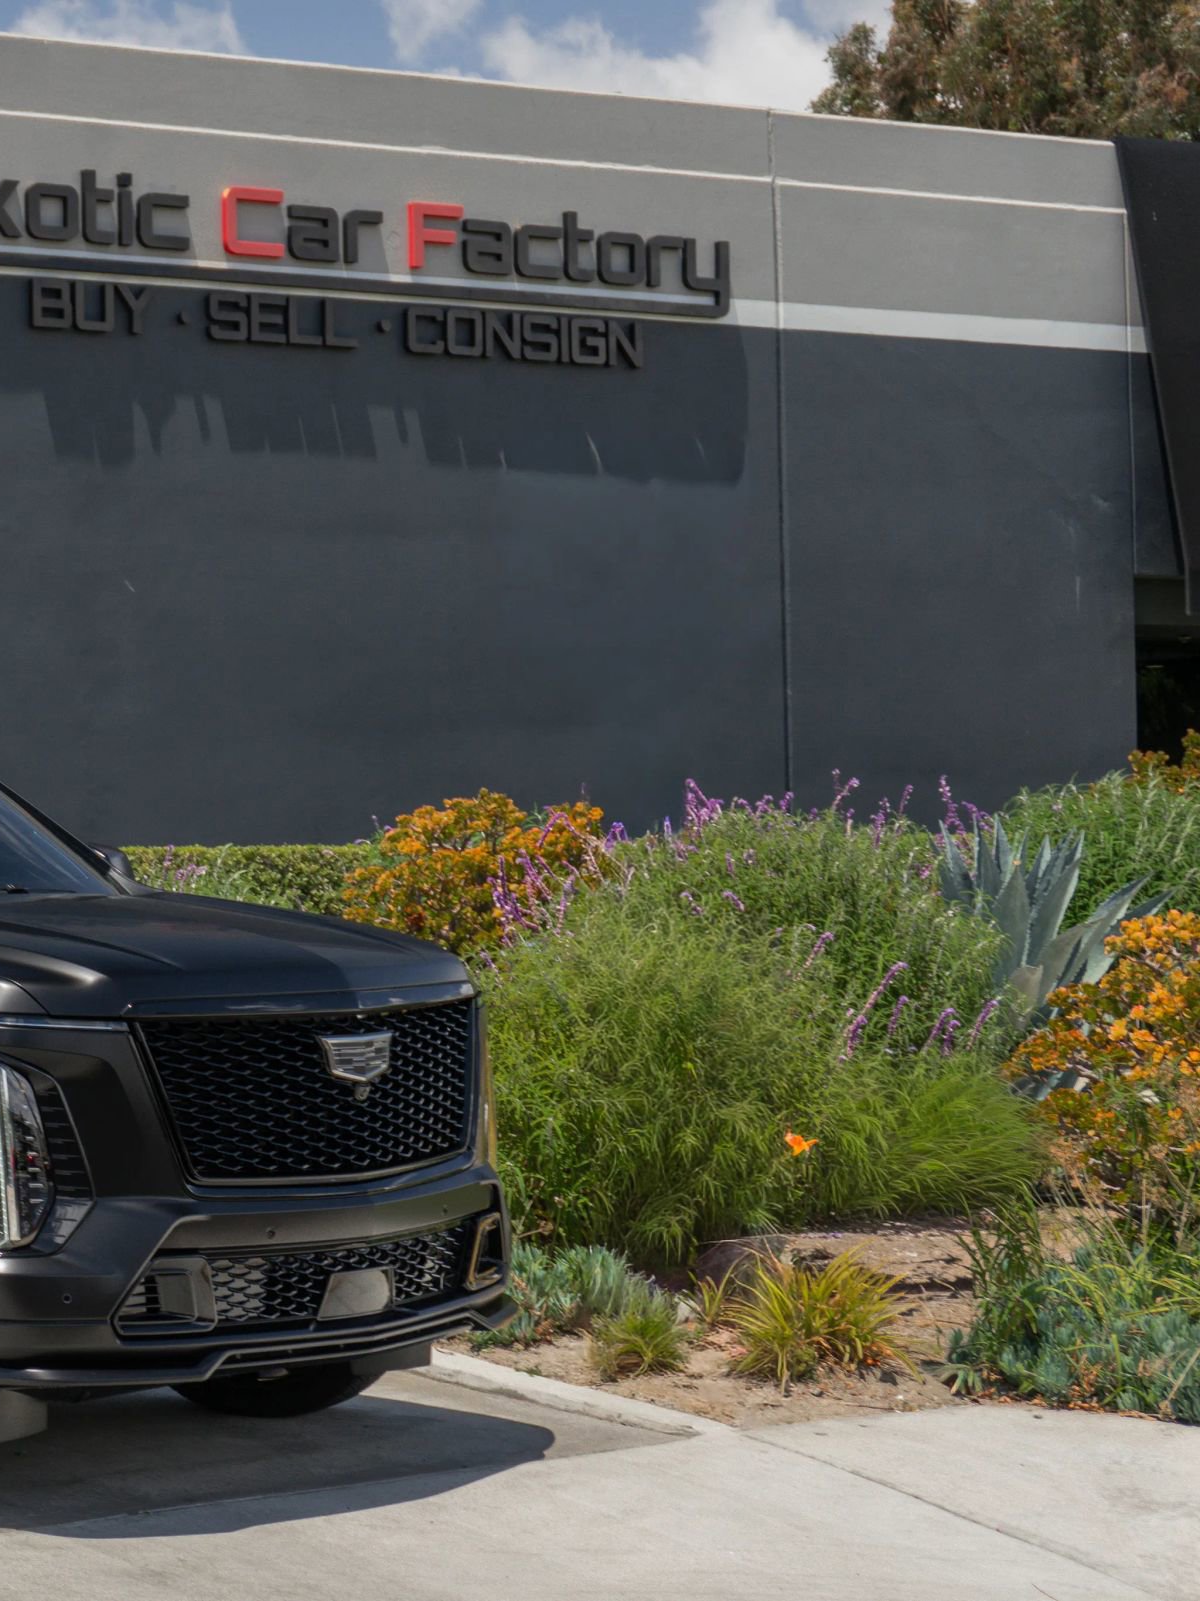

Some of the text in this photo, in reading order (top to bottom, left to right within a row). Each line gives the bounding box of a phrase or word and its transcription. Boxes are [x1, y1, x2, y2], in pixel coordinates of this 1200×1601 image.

[220, 186, 384, 264] Car
[406, 201, 731, 318] Factory
[30, 278, 644, 369] BUY SELL CONSIGN
